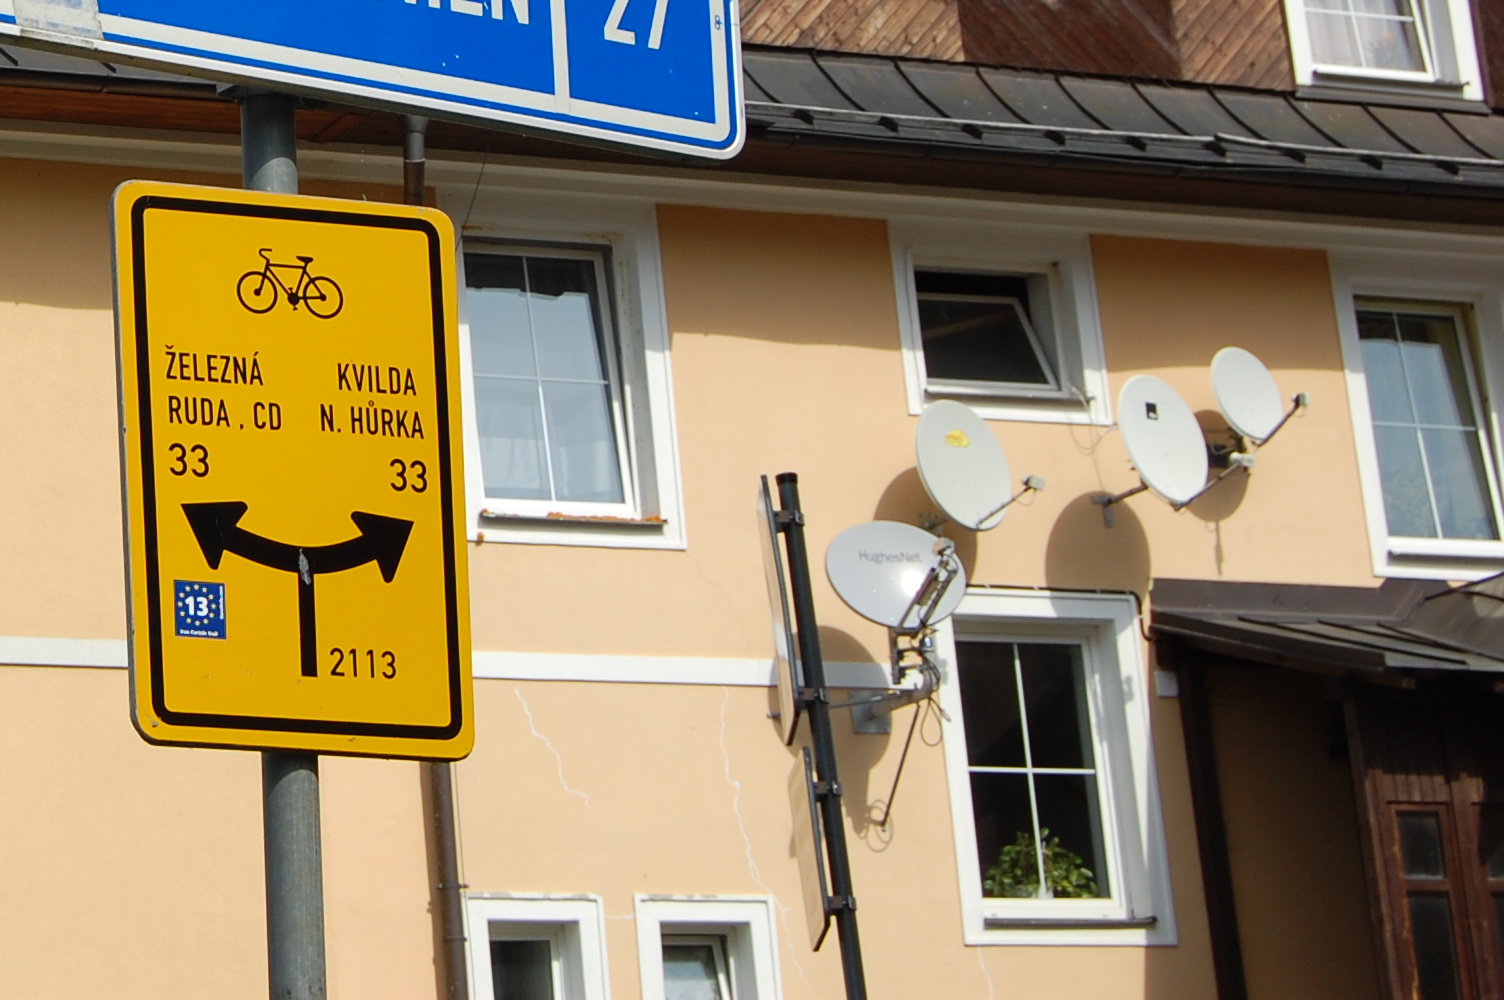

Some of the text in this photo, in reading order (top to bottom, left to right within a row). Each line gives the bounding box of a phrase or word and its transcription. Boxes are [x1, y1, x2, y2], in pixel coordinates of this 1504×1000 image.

[165, 343, 264, 386] ŽELEZNÁ
[337, 363, 417, 396] KVILDA
[168, 395, 231, 428] RUDA
[253, 401, 282, 431] CD
[320, 400, 425, 440] N. HŮRKA
[168, 443, 209, 478] 33
[389, 458, 428, 493] 33
[184, 595, 209, 617] 13
[330, 647, 397, 680] 2113
